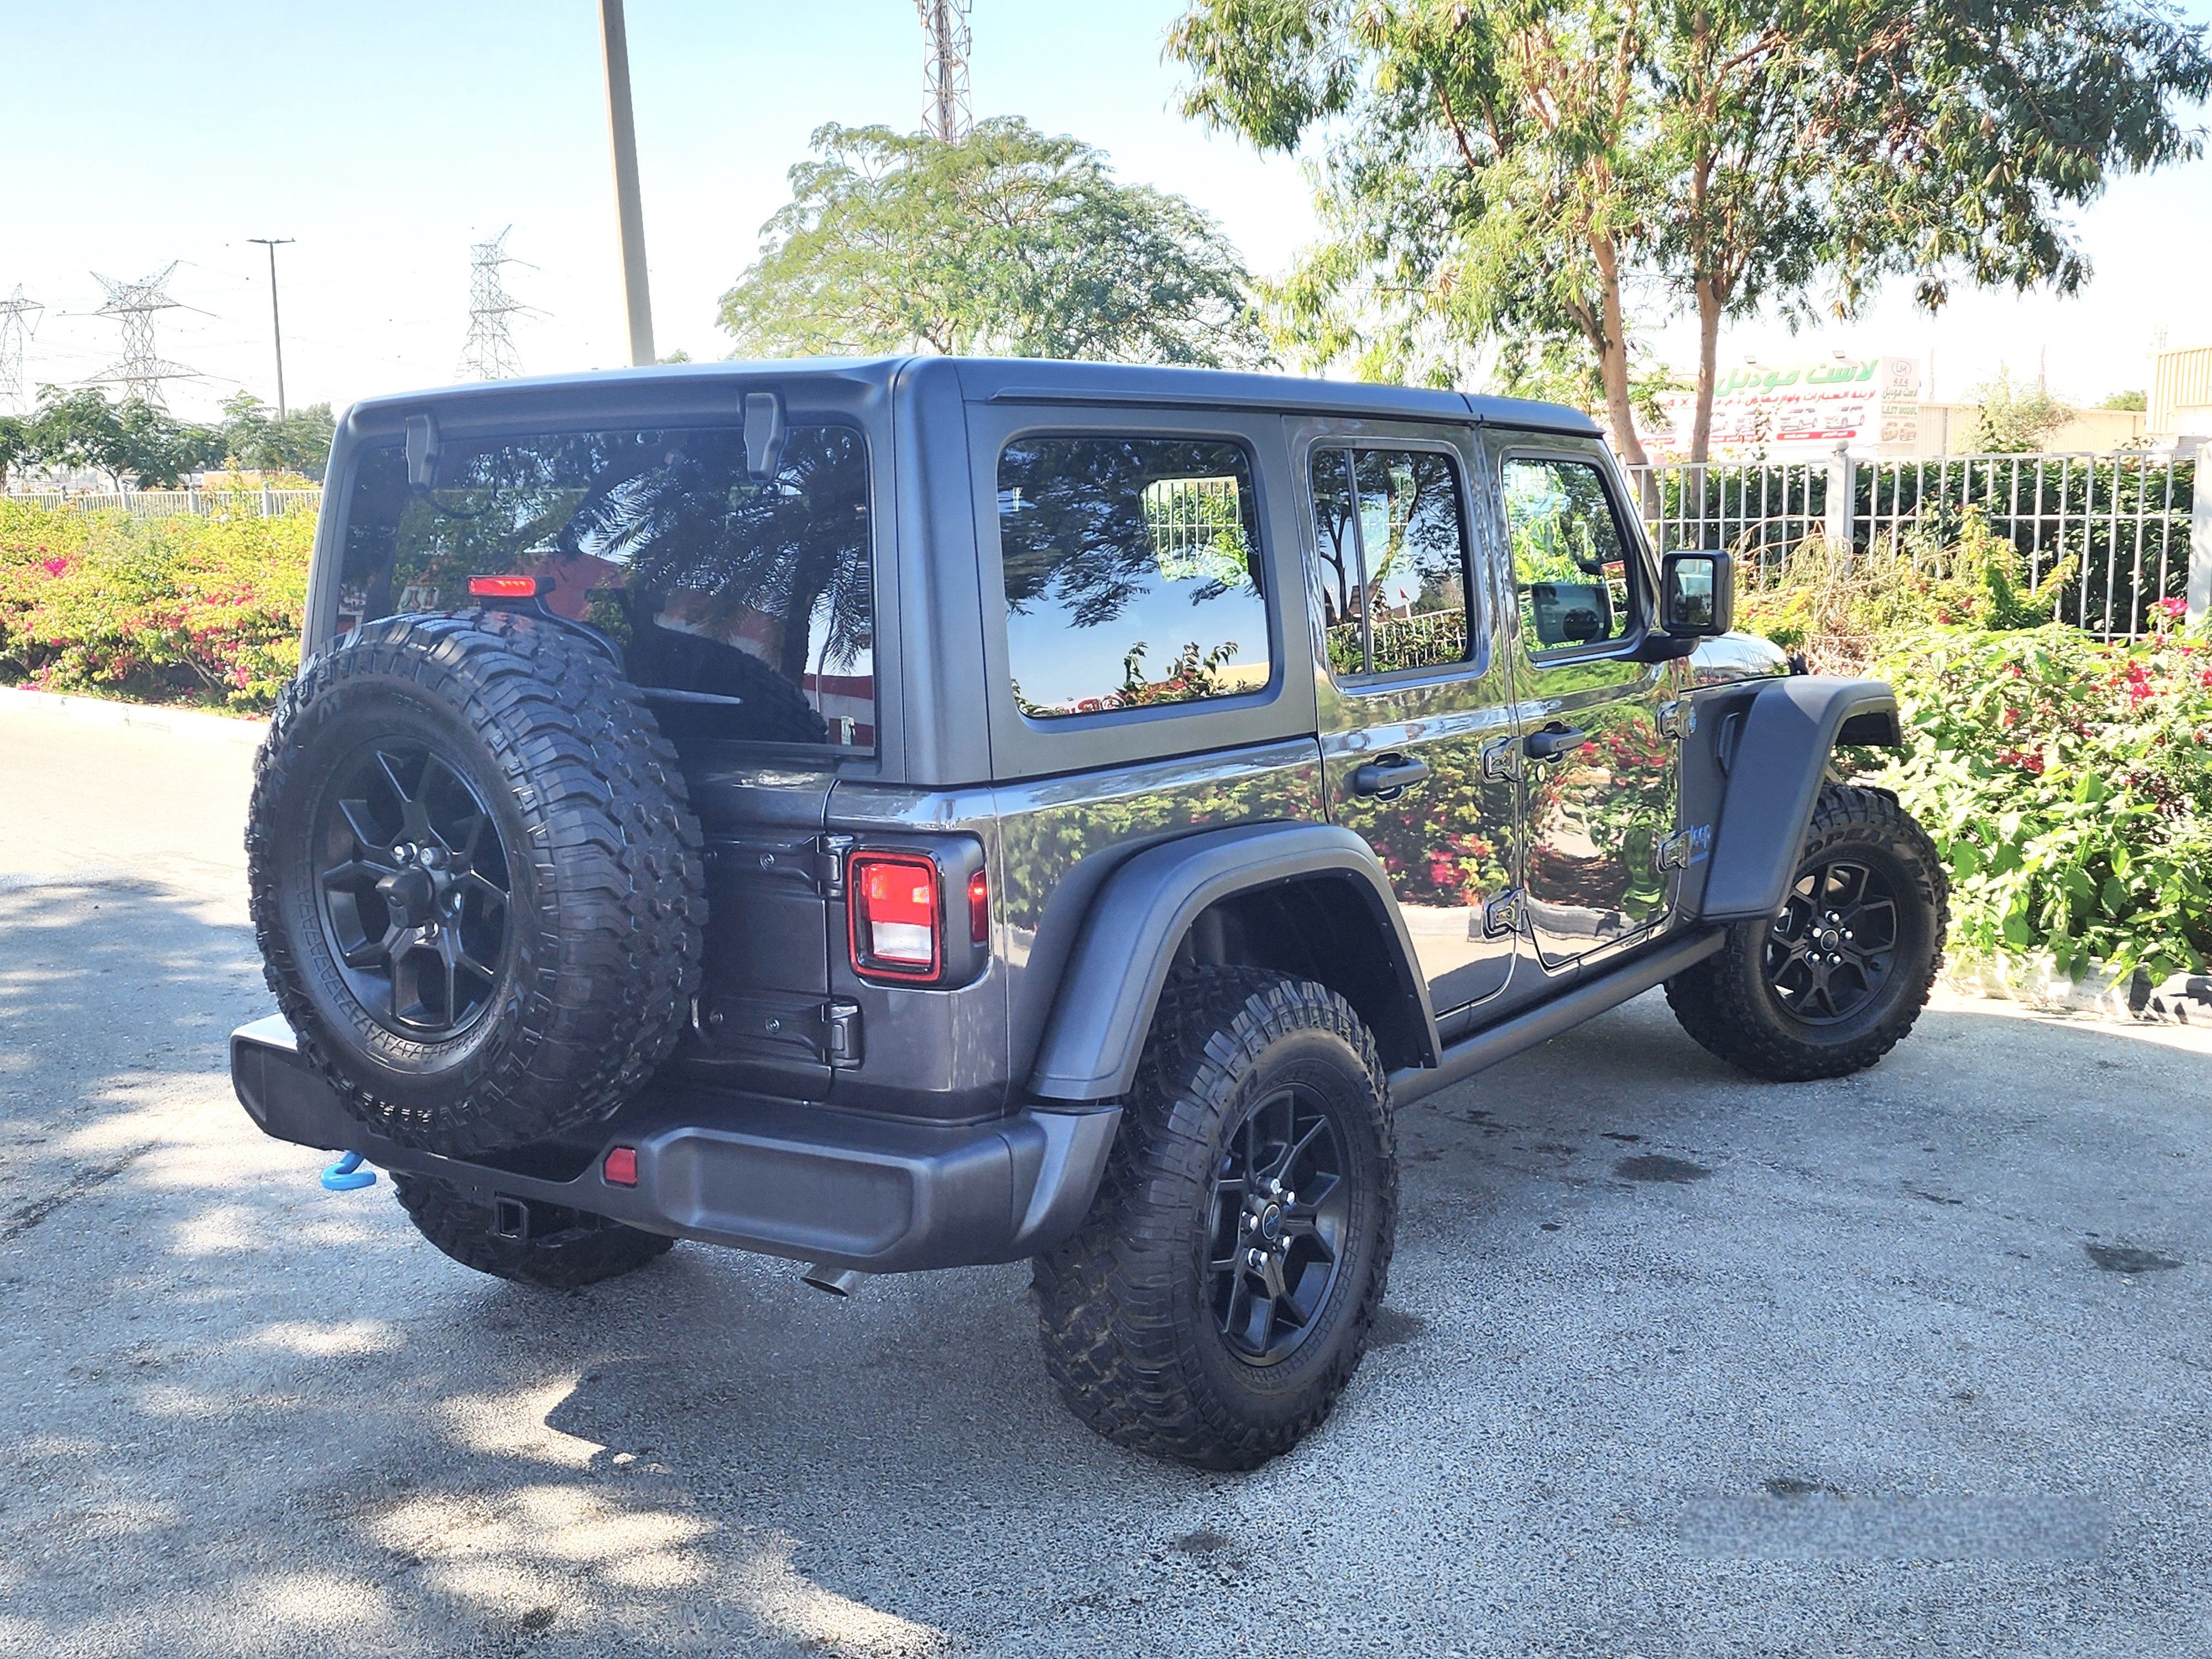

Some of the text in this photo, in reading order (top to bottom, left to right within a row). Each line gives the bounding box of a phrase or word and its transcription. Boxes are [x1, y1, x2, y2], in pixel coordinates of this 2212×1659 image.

[1713, 359, 1879, 397] لاست موديل
[1893, 377, 1908, 385] 4X4
[1803, 391, 1849, 403] السيارات
